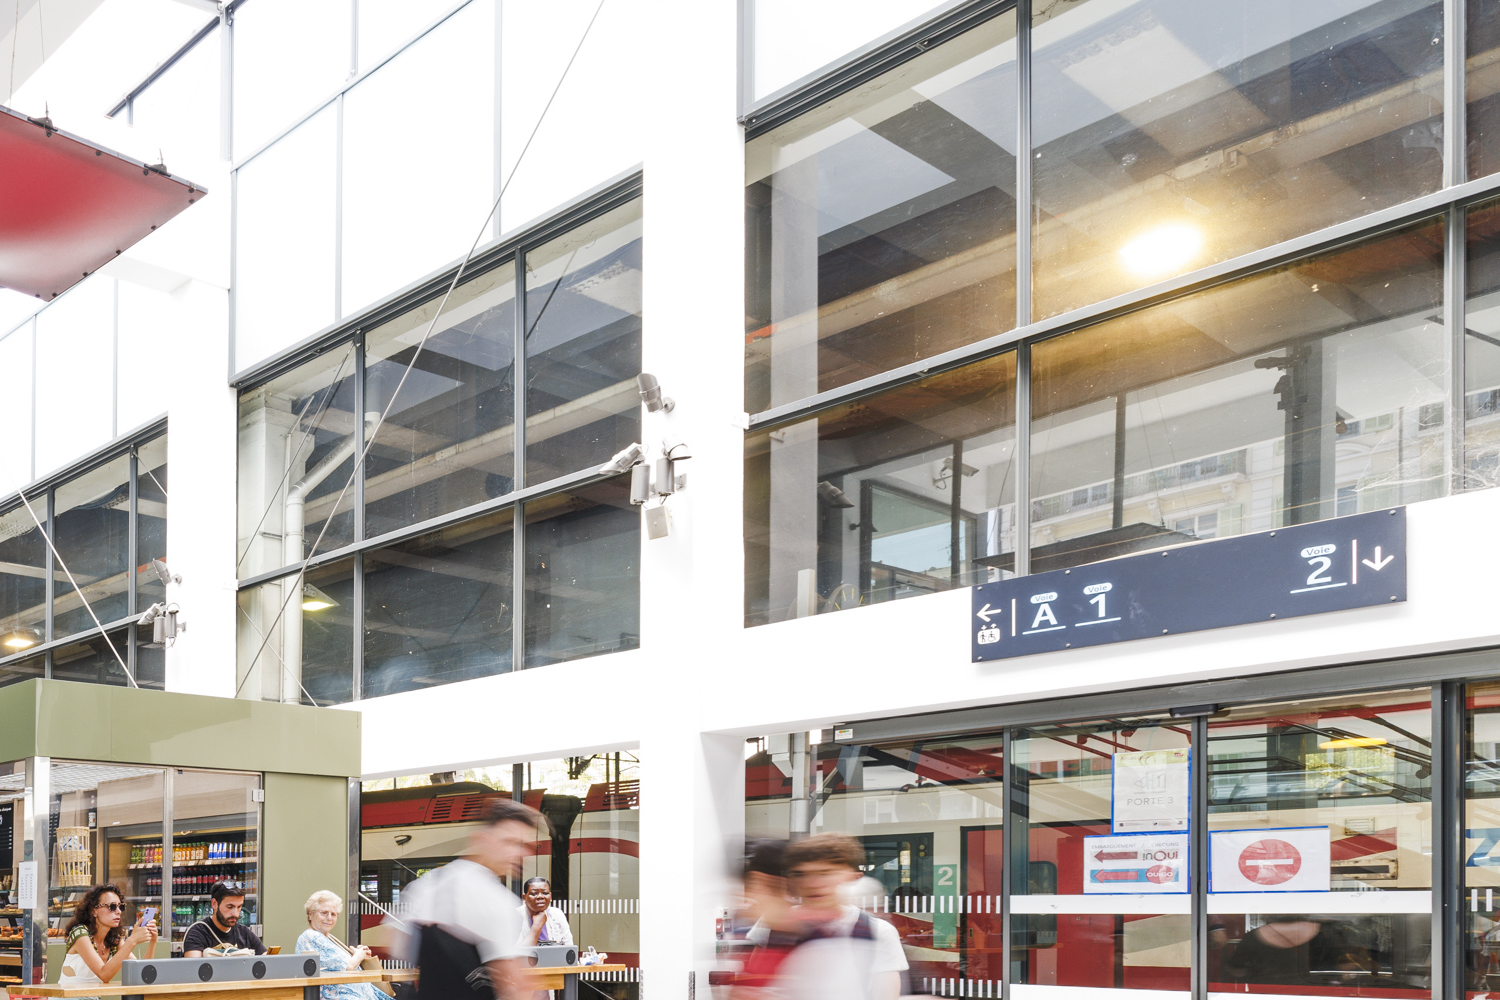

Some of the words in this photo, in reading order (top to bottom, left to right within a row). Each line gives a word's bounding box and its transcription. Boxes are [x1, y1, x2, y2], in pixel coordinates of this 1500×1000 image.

[1306, 546, 1331, 556] Voie
[1306, 556, 1332, 586] 2
[1087, 584, 1108, 593] Voie
[1034, 594, 1054, 602] Voie
[1089, 593, 1106, 618] 1
[1031, 602, 1058, 628] A
[1126, 797, 1164, 806] PORTE
[1167, 796, 1174, 804] 3
[937, 866, 954, 886] 2
